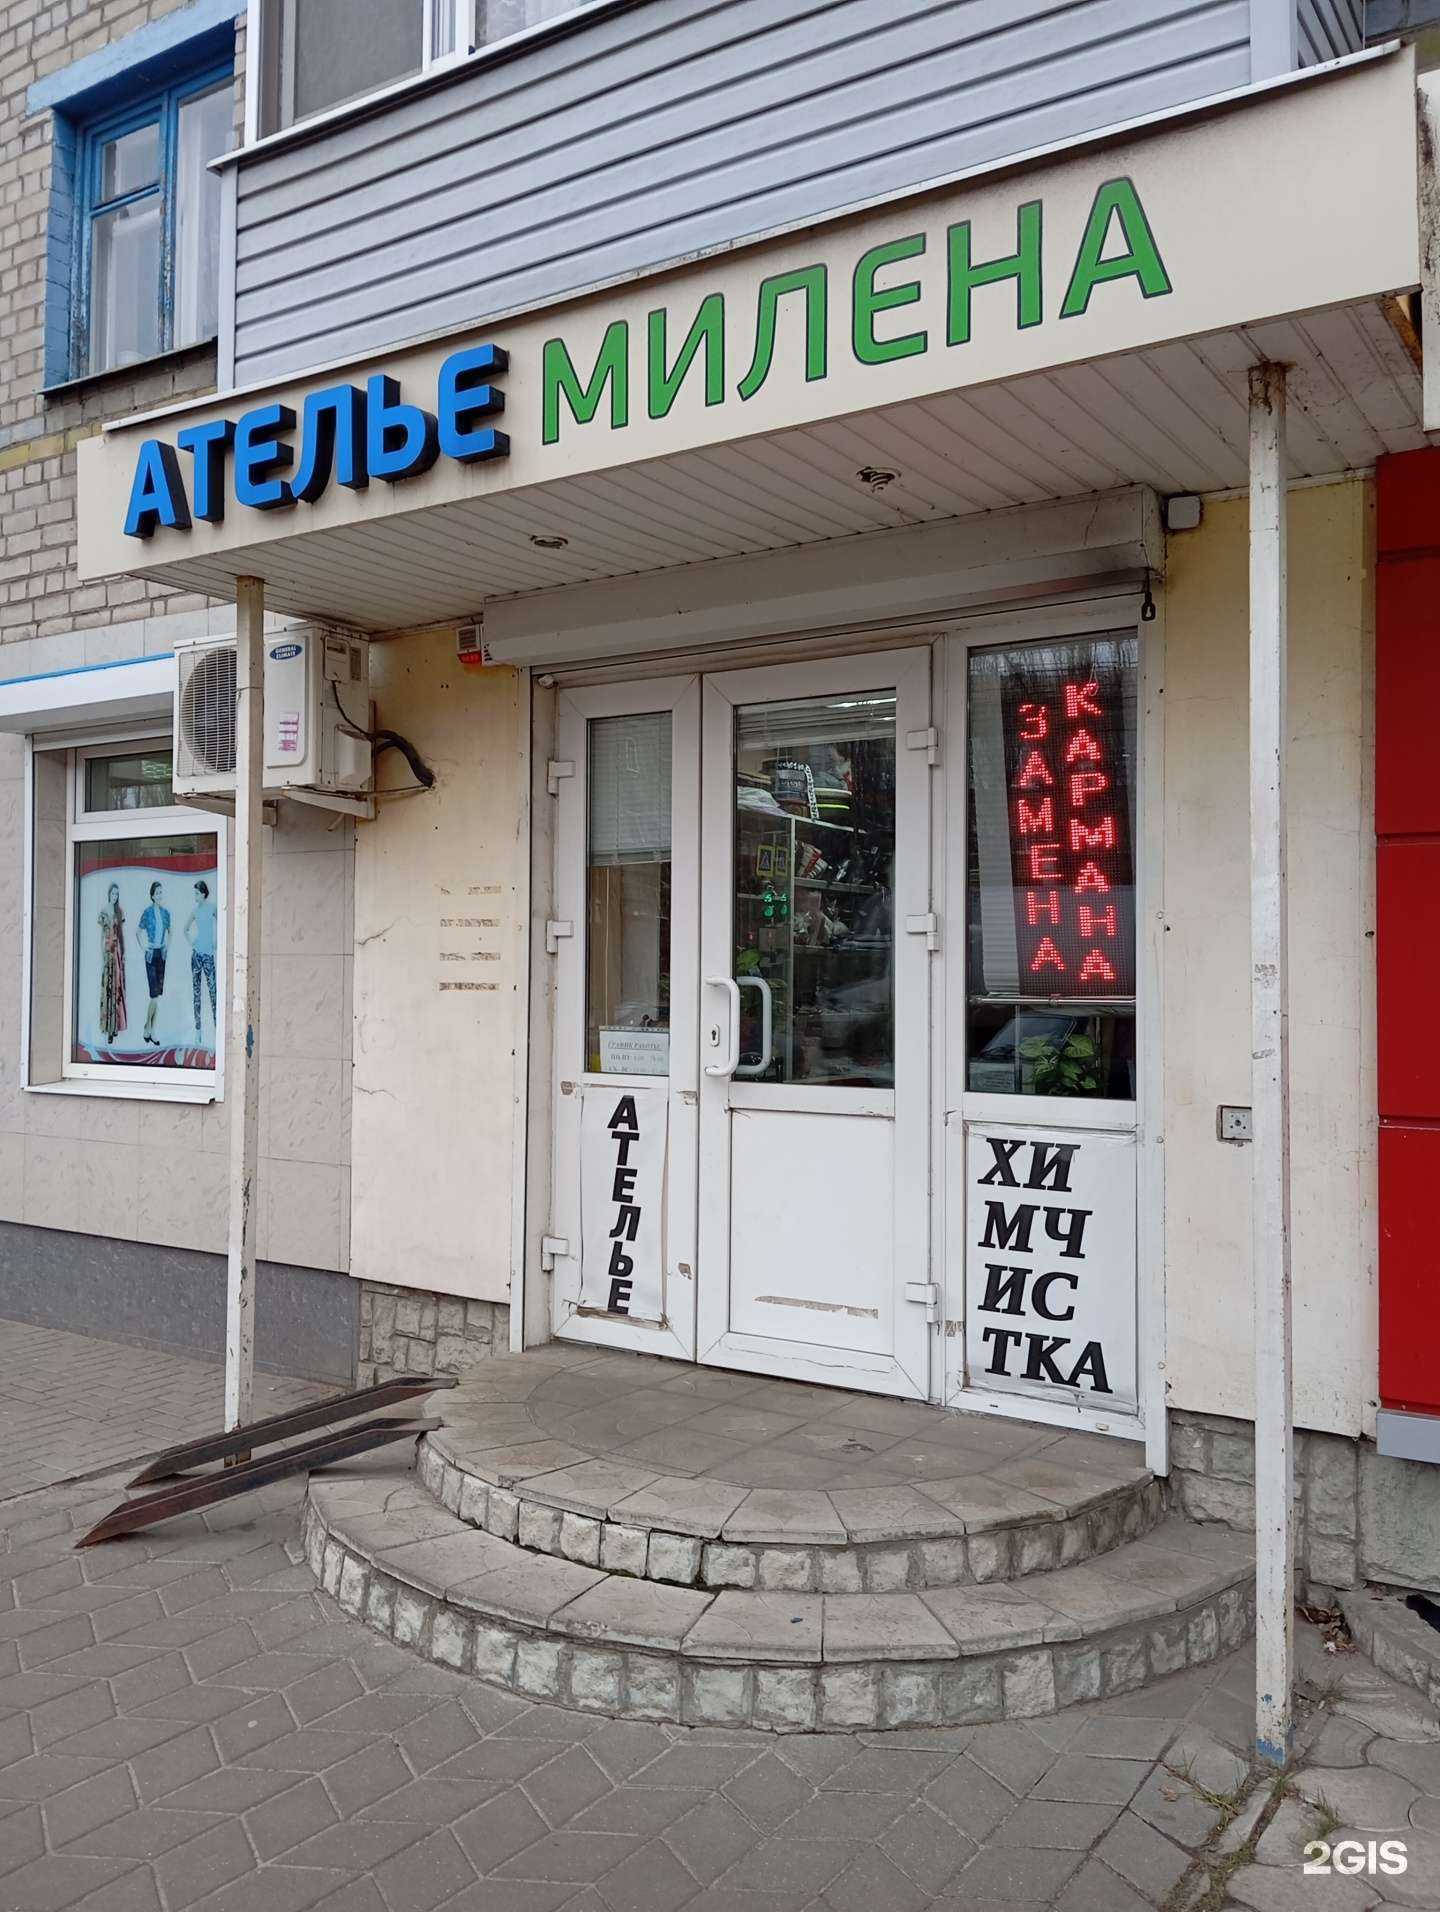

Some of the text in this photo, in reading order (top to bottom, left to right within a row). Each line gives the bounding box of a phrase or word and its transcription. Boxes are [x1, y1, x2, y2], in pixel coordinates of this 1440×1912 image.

[123, 176, 1173, 540] АТЕЛЬЕ МИЛЕНА
[1018, 703, 1066, 971] ЗАМЕНА
[1064, 682, 1117, 980] КАРМАНА
[607, 1094, 641, 1315] АТЕЛЬЕ
[977, 1137, 1082, 1193] ХИ
[977, 1200, 1093, 1259] МЧ
[977, 1263, 1079, 1321] ИС
[982, 1326, 1113, 1394] ТКА
